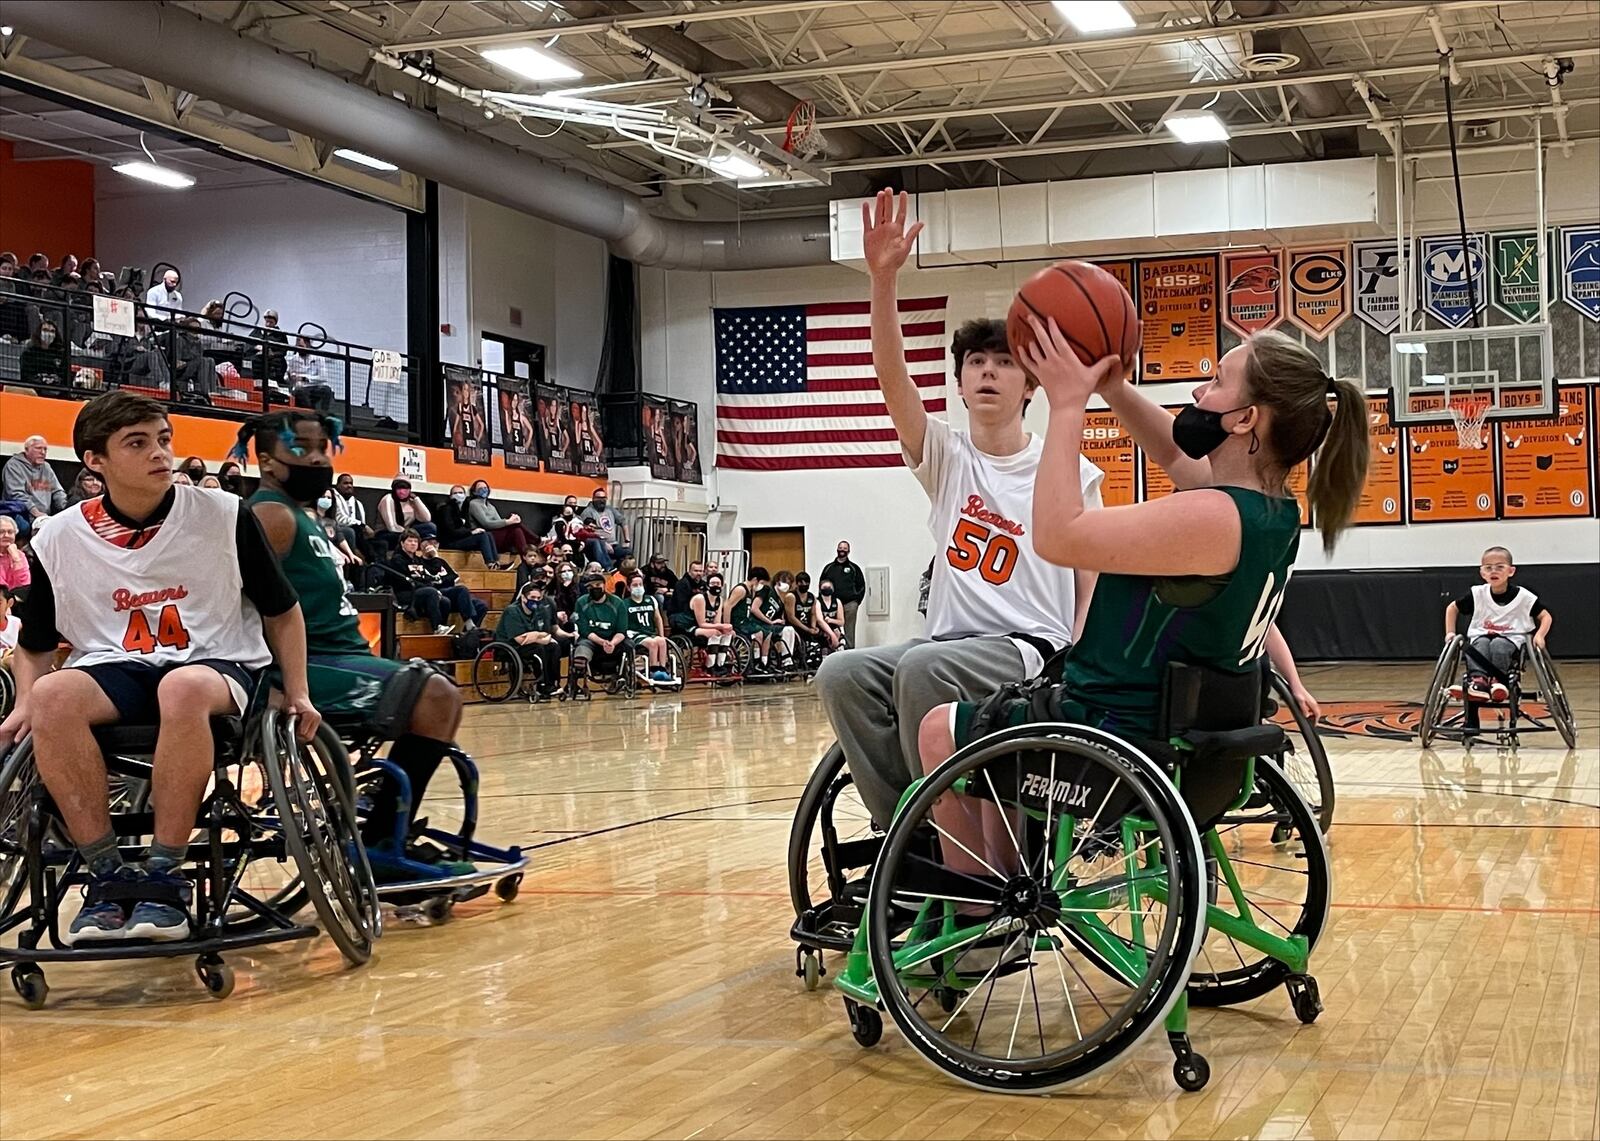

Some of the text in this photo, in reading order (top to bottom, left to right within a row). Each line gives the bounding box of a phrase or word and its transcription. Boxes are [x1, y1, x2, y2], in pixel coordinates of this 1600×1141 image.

[1142, 262, 1212, 281] BASEBALL
[1430, 250, 1478, 282] M
[1320, 270, 1343, 279] ELKS
[1155, 274, 1201, 288] 1952
[1143, 281, 1213, 300] STATE CHAMPIONS
[1432, 290, 1479, 301] MIAMISBUG
[1503, 286, 1540, 295] NORTHMO
[1298, 299, 1339, 309] CENTERVILLE
[1367, 295, 1400, 304] FAIRMON
[1440, 299, 1470, 308] VIKINGS
[1160, 303, 1193, 312] DIVISION
[1232, 303, 1275, 314] BEAVERCREEK
[1311, 308, 1327, 316] ELKS
[1367, 303, 1400, 312] FIREBIRD
[1240, 312, 1267, 321] BEAVERS
[373, 350, 386, 363] GO
[1504, 391, 1583, 408] BOYS BLING
[1411, 399, 1440, 413] GIRLS
[1083, 428, 1120, 439] 996
[1523, 434, 1560, 443] DIVISION
[1090, 436, 1132, 450] CHAMPIONS
[408, 448, 418, 458] The
[961, 494, 1025, 536] Beavers
[946, 517, 1019, 586] 50
[112, 584, 189, 612] Beavers
[636, 611, 650, 627] 41
[121, 604, 191, 655] 44
